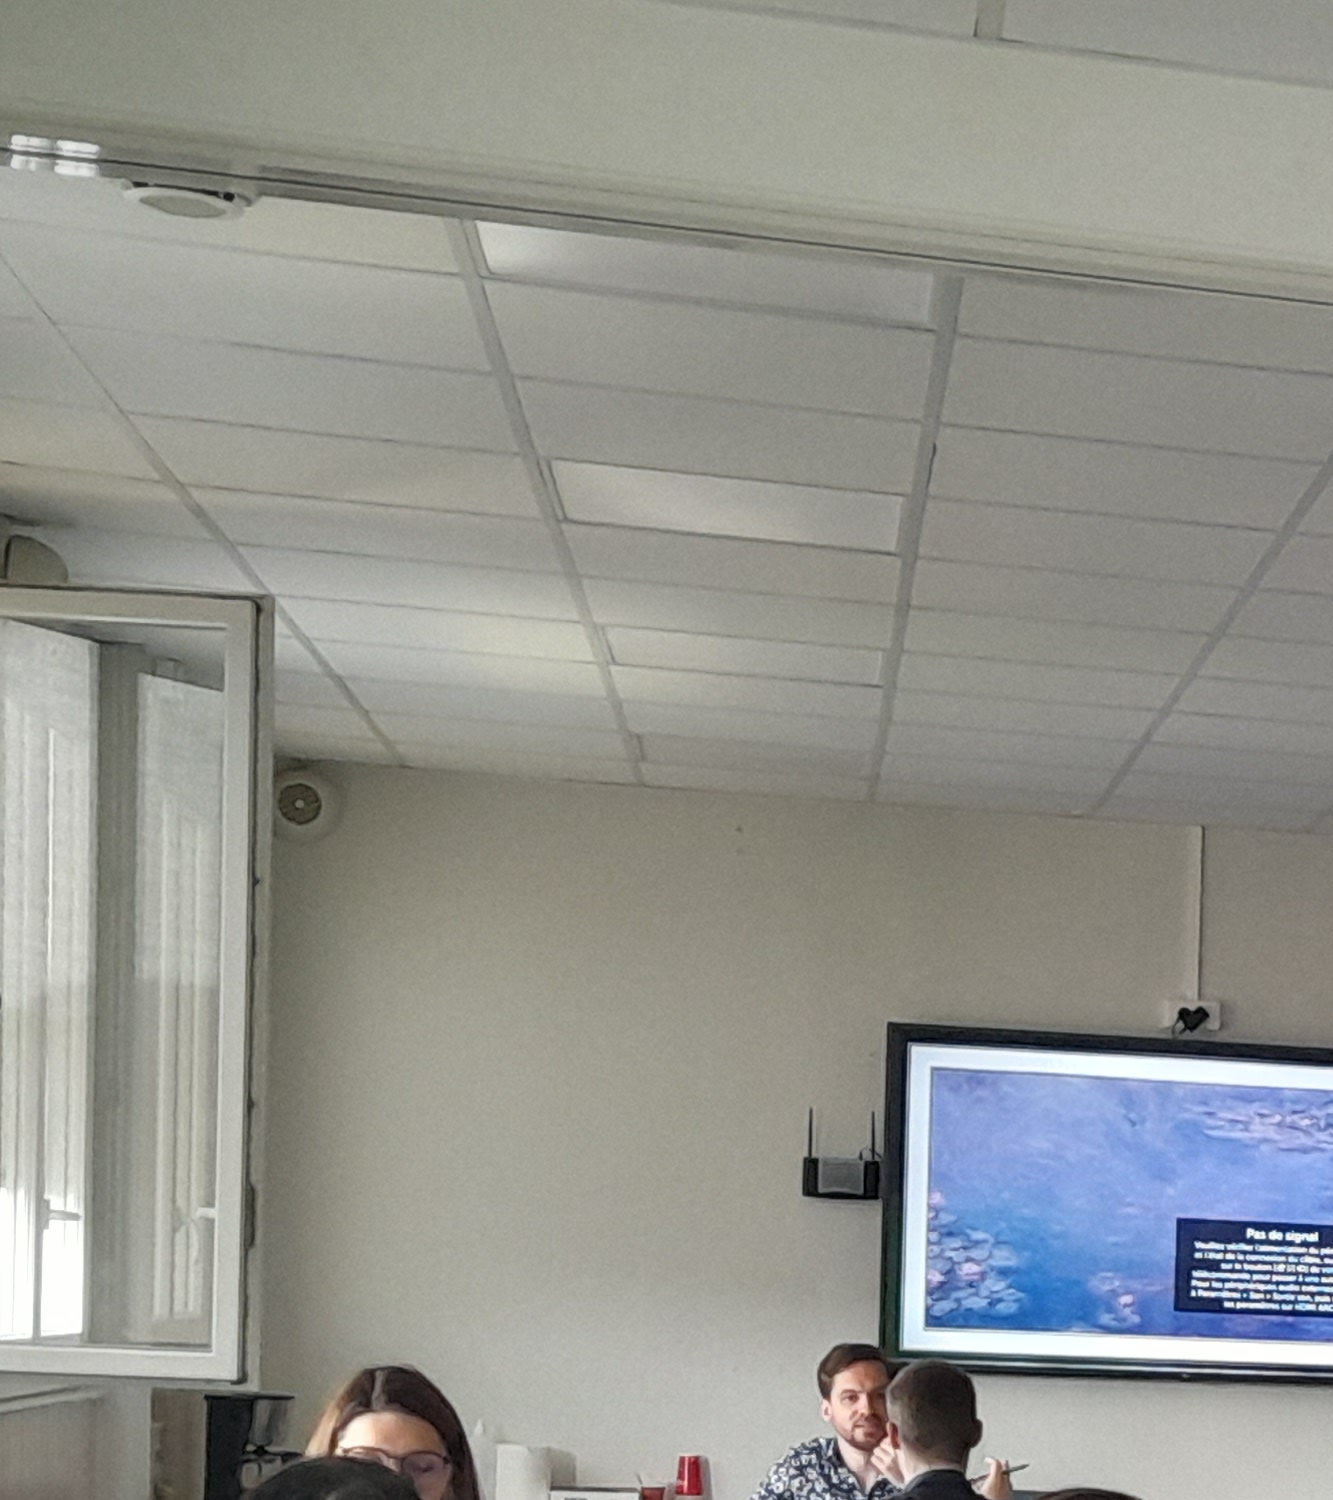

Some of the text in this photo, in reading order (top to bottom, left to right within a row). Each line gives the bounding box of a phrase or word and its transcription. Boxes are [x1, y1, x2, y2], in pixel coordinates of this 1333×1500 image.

[1246, 1227, 1319, 1243] Pas de signal
